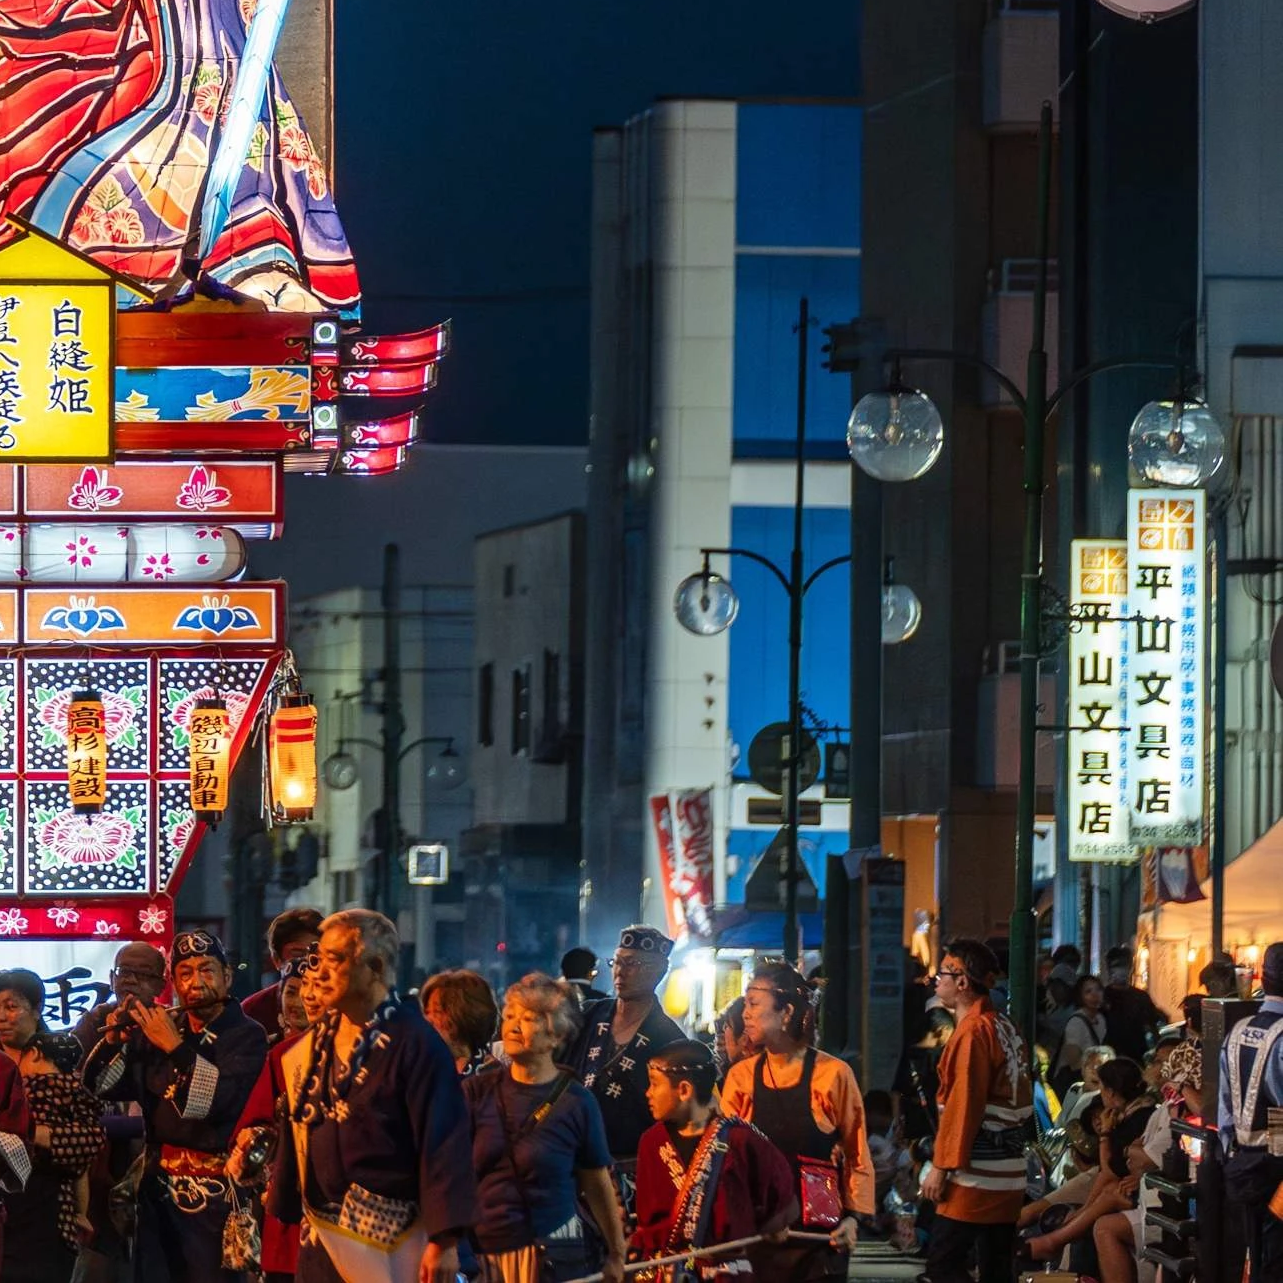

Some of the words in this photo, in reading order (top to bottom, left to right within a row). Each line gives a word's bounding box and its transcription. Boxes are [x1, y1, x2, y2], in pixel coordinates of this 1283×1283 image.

[47, 300, 94, 414] 白縫姫
[1078, 602, 1113, 834] 平山文具店
[1135, 565, 1173, 814] 平山文具店
[71, 707, 102, 797] 高杉建設
[192, 716, 222, 807] 磯辺自動車
[584, 1022, 610, 1088] 下平井
[605, 1033, 650, 1098] 下平井
